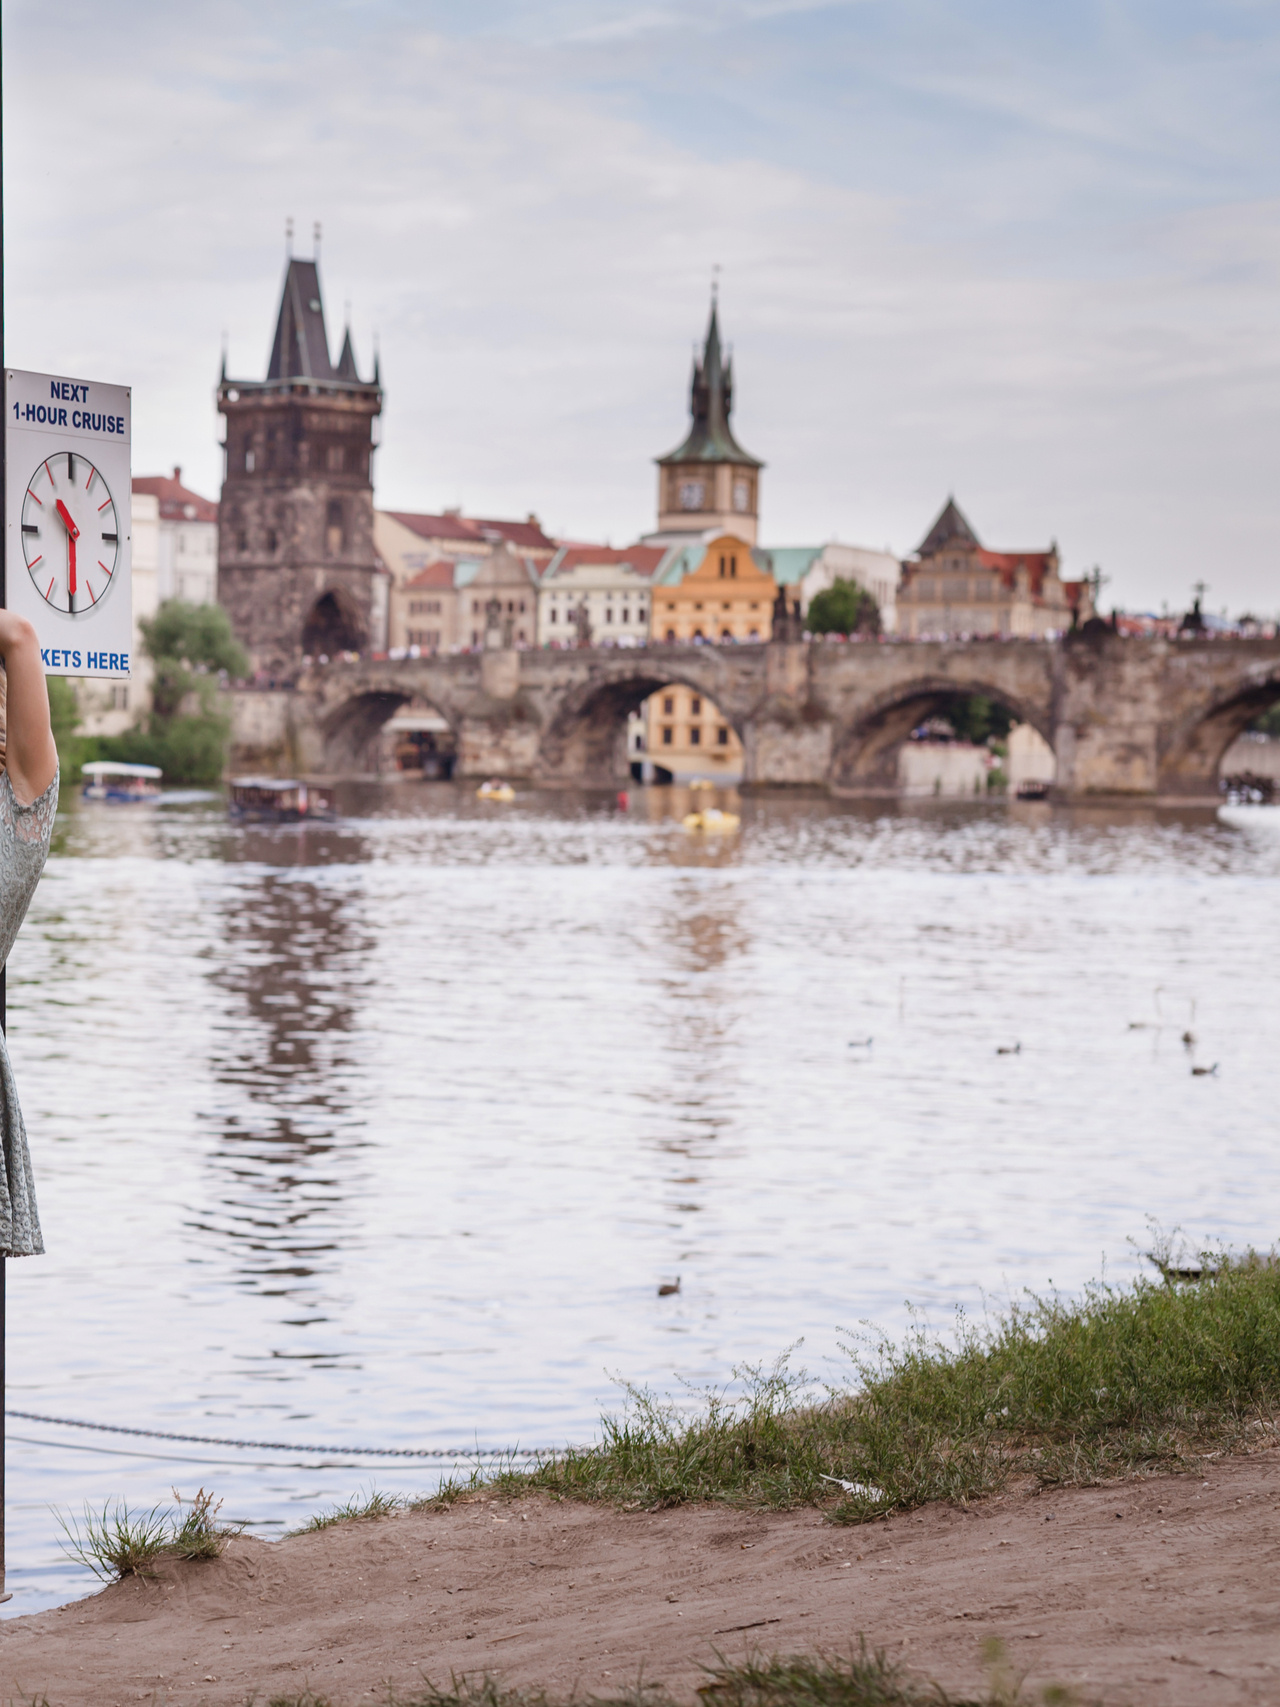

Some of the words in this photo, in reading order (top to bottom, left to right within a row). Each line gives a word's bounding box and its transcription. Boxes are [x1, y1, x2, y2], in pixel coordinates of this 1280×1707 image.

[50, 381, 89, 404] NEXT
[13, 402, 68, 427] 1-HOUR
[72, 409, 125, 435] CRUISE
[40, 648, 82, 669] KETS
[87, 652, 129, 671] HERE
